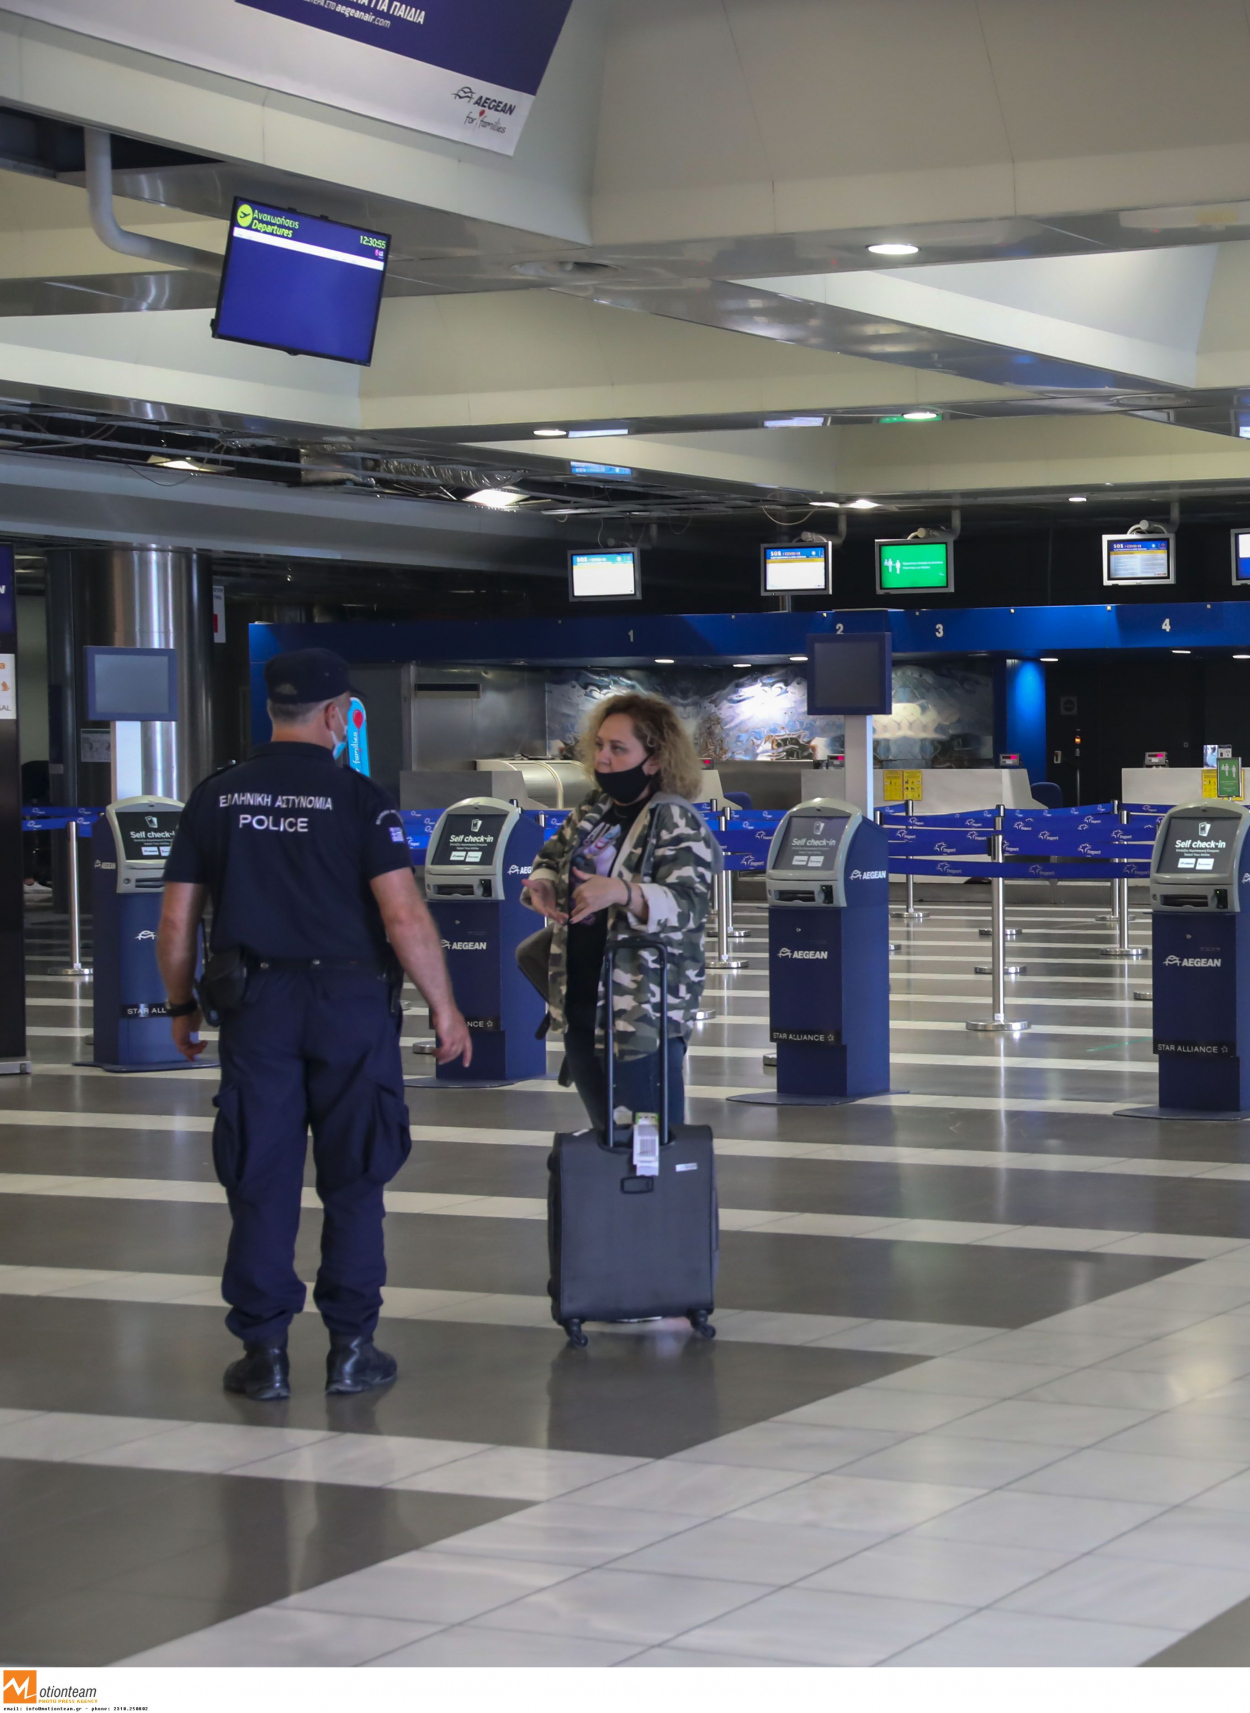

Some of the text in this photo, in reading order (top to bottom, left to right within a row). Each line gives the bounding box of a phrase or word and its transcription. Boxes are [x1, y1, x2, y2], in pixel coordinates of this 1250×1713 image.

[335, 3, 391, 28] aegeanair.com
[389, 1, 426, 25] ΠΑΙΔΙΑ
[473, 96, 516, 116] AEGEAN
[252, 220, 293, 238] Departures
[360, 235, 386, 249] 12:30:55
[835, 623, 844, 634] 2
[935, 624, 944, 637] 3
[1161, 618, 1171, 632] 4
[628, 629, 634, 642] 1
[351, 732, 361, 765] families
[275, 795, 333, 811] ΑΣΤΥΝΟΜΙΑ
[239, 814, 309, 833] POLICE
[449, 835, 494, 843] Self check-in
[791, 838, 836, 846] Self check-in
[1175, 840, 1226, 849] Self check-in
[520, 866, 532, 875] AEG
[862, 870, 887, 880] AEGEAN
[452, 942, 487, 950] AEGEAN
[792, 950, 829, 959] AEGEAN
[1181, 958, 1222, 967] AEGEAN
[773, 1032, 825, 1042] STAR ALLIANCE
[1177, 1045, 1219, 1053] ALLIANCE
